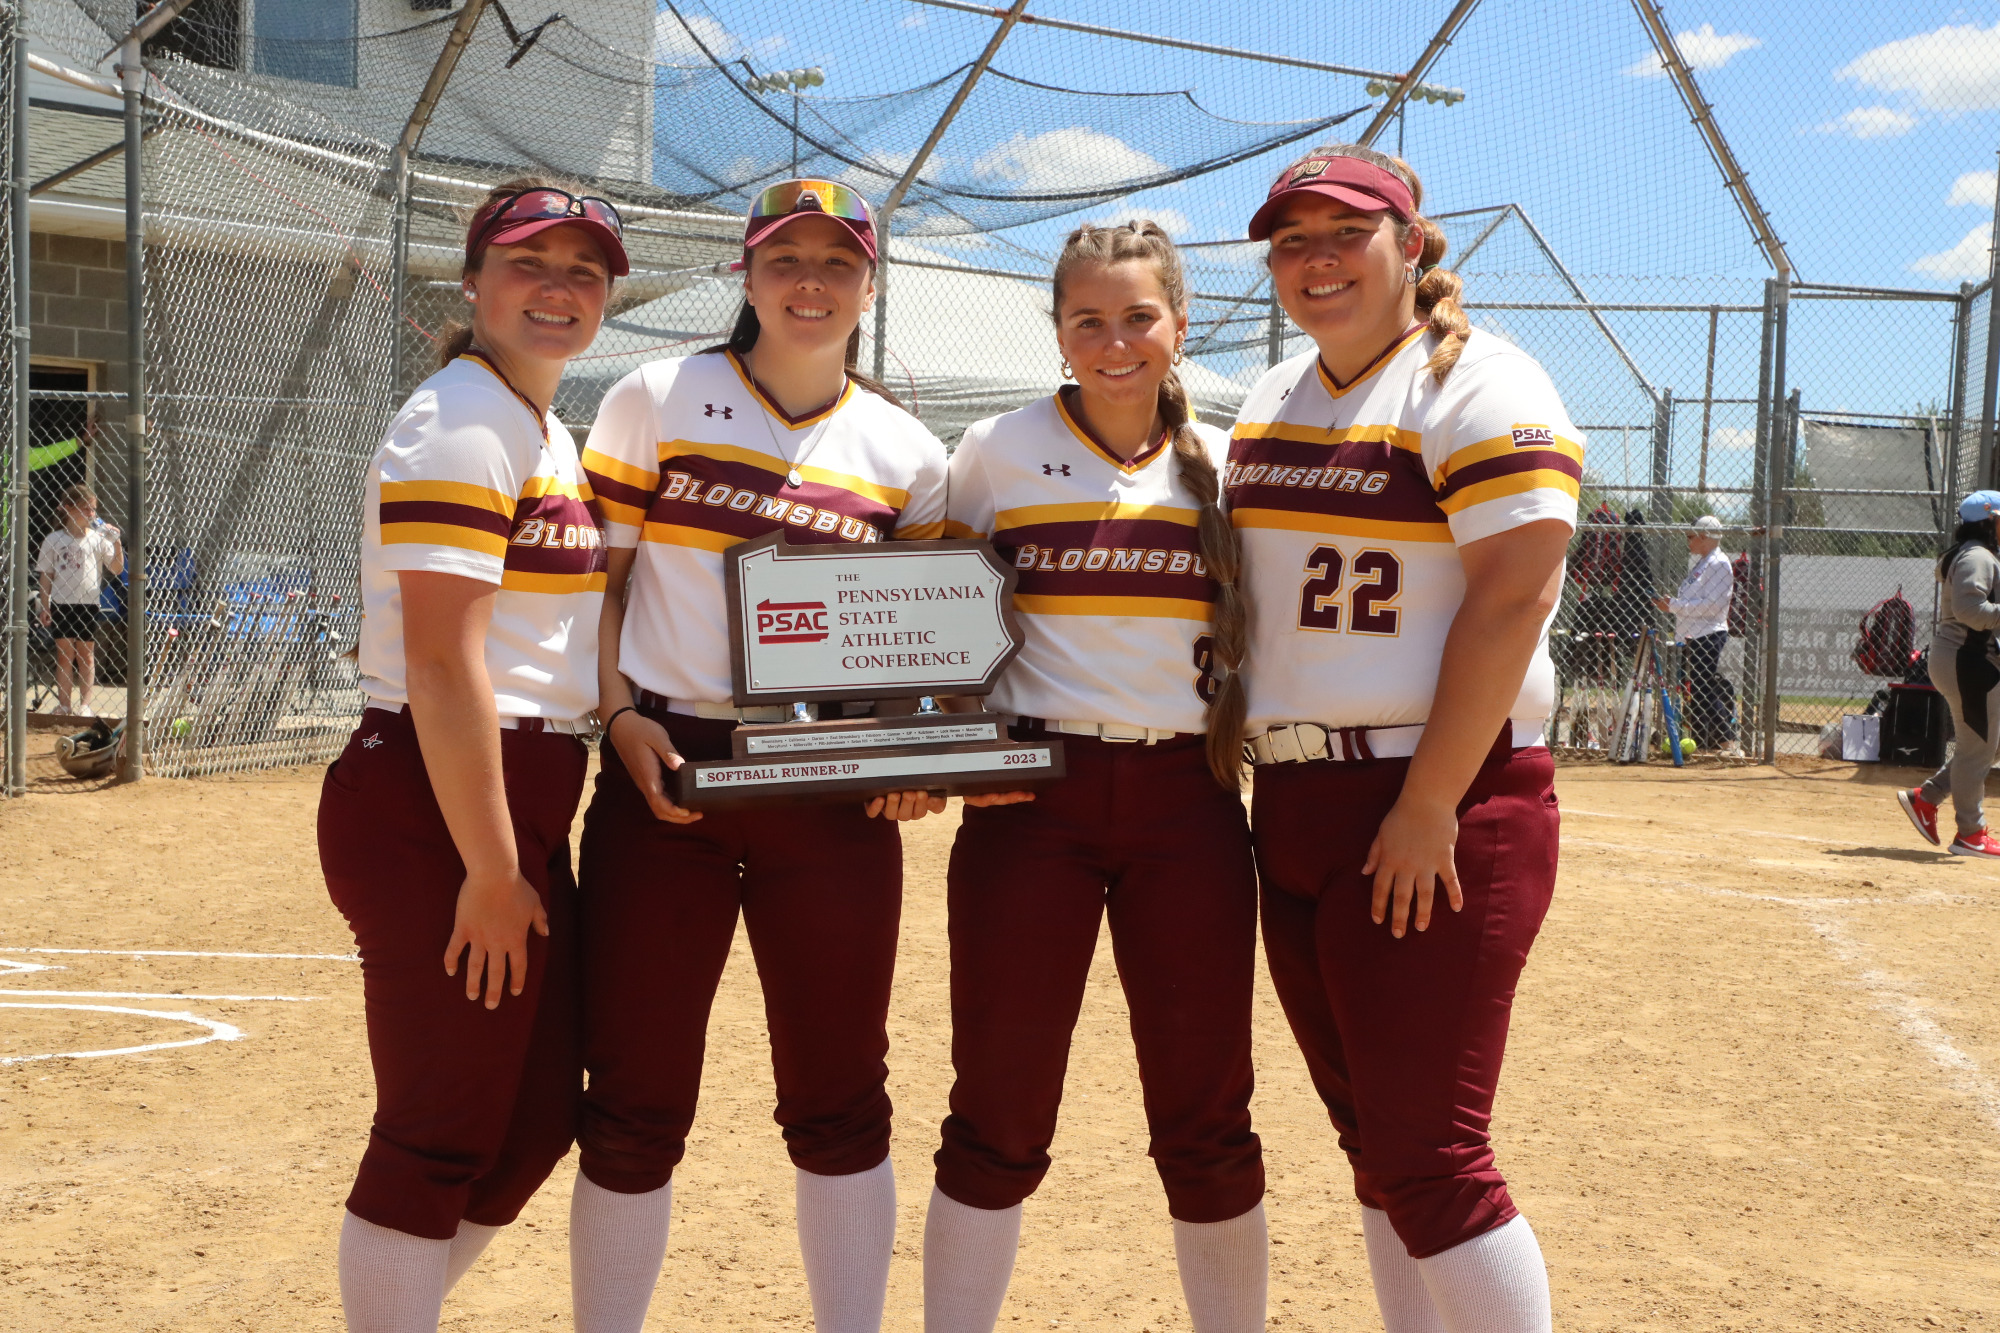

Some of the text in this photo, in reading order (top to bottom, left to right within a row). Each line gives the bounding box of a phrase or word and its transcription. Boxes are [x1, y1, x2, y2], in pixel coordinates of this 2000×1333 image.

[1511, 428, 1554, 441] PSAC
[660, 471, 884, 544] BLOOMSBUR
[835, 573, 860, 582] THE
[837, 585, 985, 604] PENNSYLVANIA
[1297, 542, 1403, 638] 22
[757, 611, 829, 633] PSAC
[839, 610, 898, 625] STATE
[841, 630, 936, 648] ATHLETIC
[842, 651, 971, 670] CONFERENCE
[1192, 632, 1222, 707] 8
[706, 753, 1037, 783] SOFTBALL RUNNER-UP 2023
